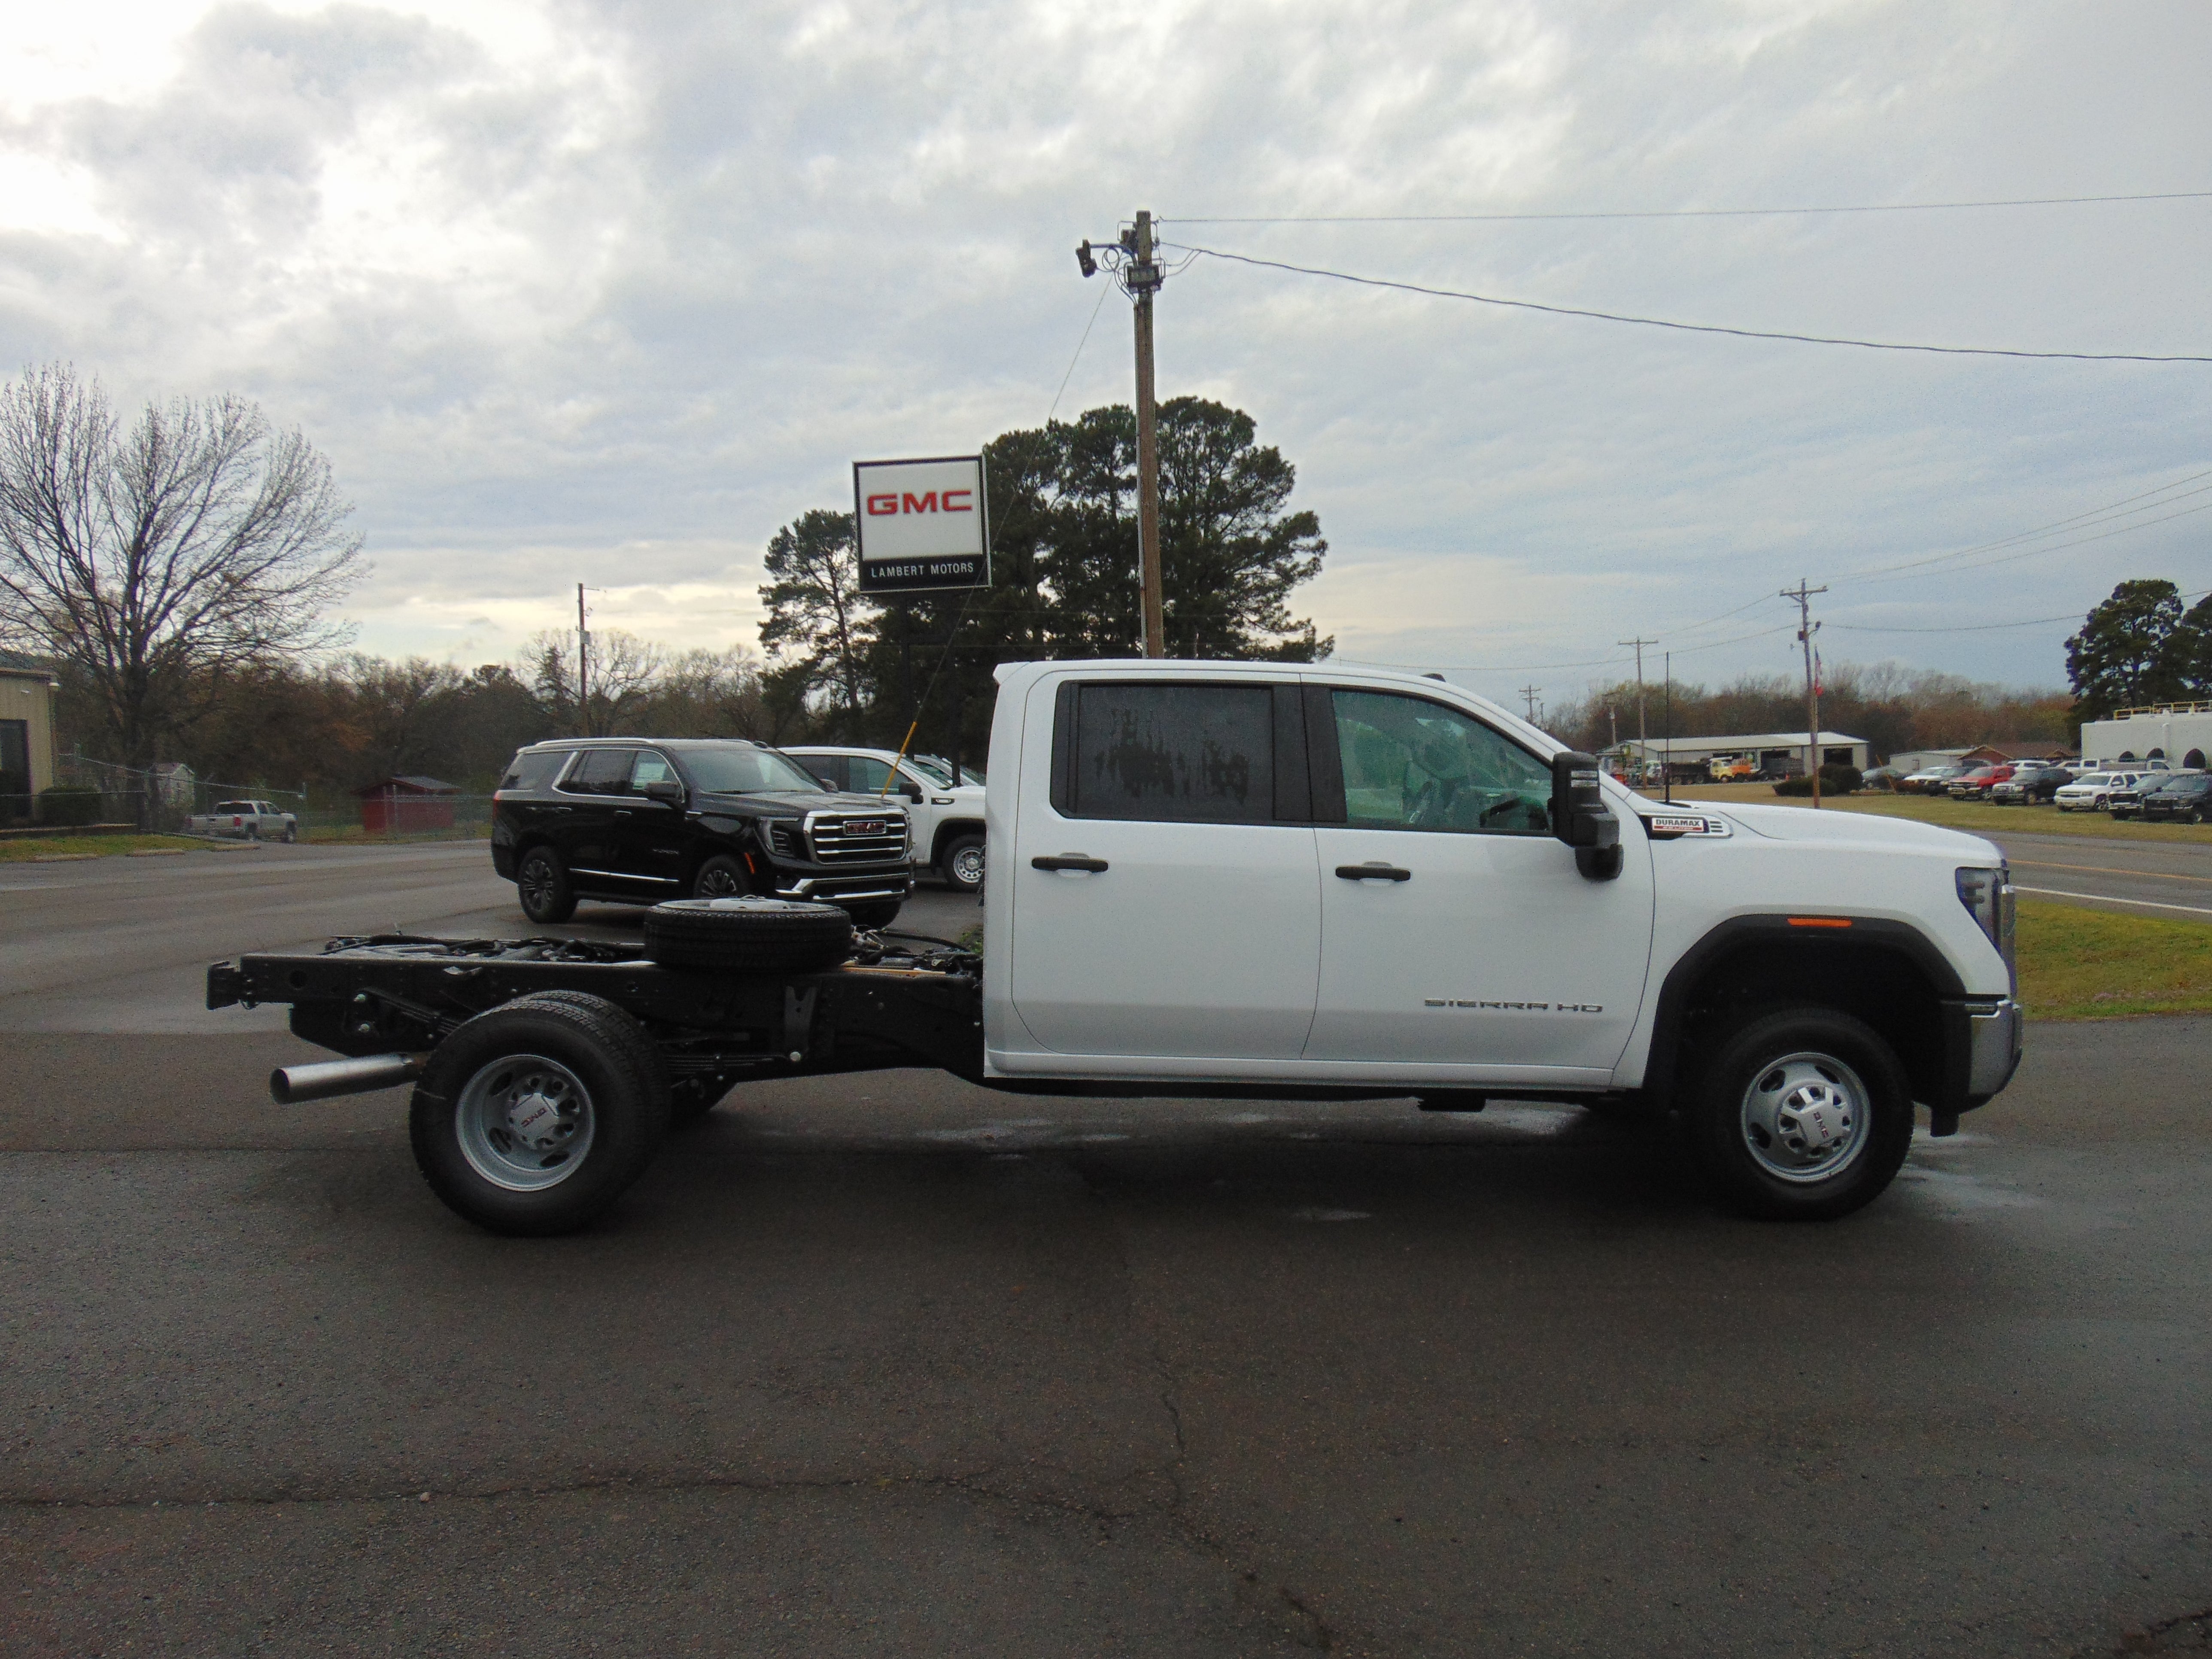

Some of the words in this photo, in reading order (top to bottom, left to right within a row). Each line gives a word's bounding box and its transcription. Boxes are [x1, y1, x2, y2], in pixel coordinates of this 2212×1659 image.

[867, 490, 972, 516] GMC
[871, 565, 924, 578] LAMBERT
[930, 562, 974, 575] MOTORS
[1425, 998, 1549, 1010] SIERRA
[1557, 1003, 1603, 1012] HD
